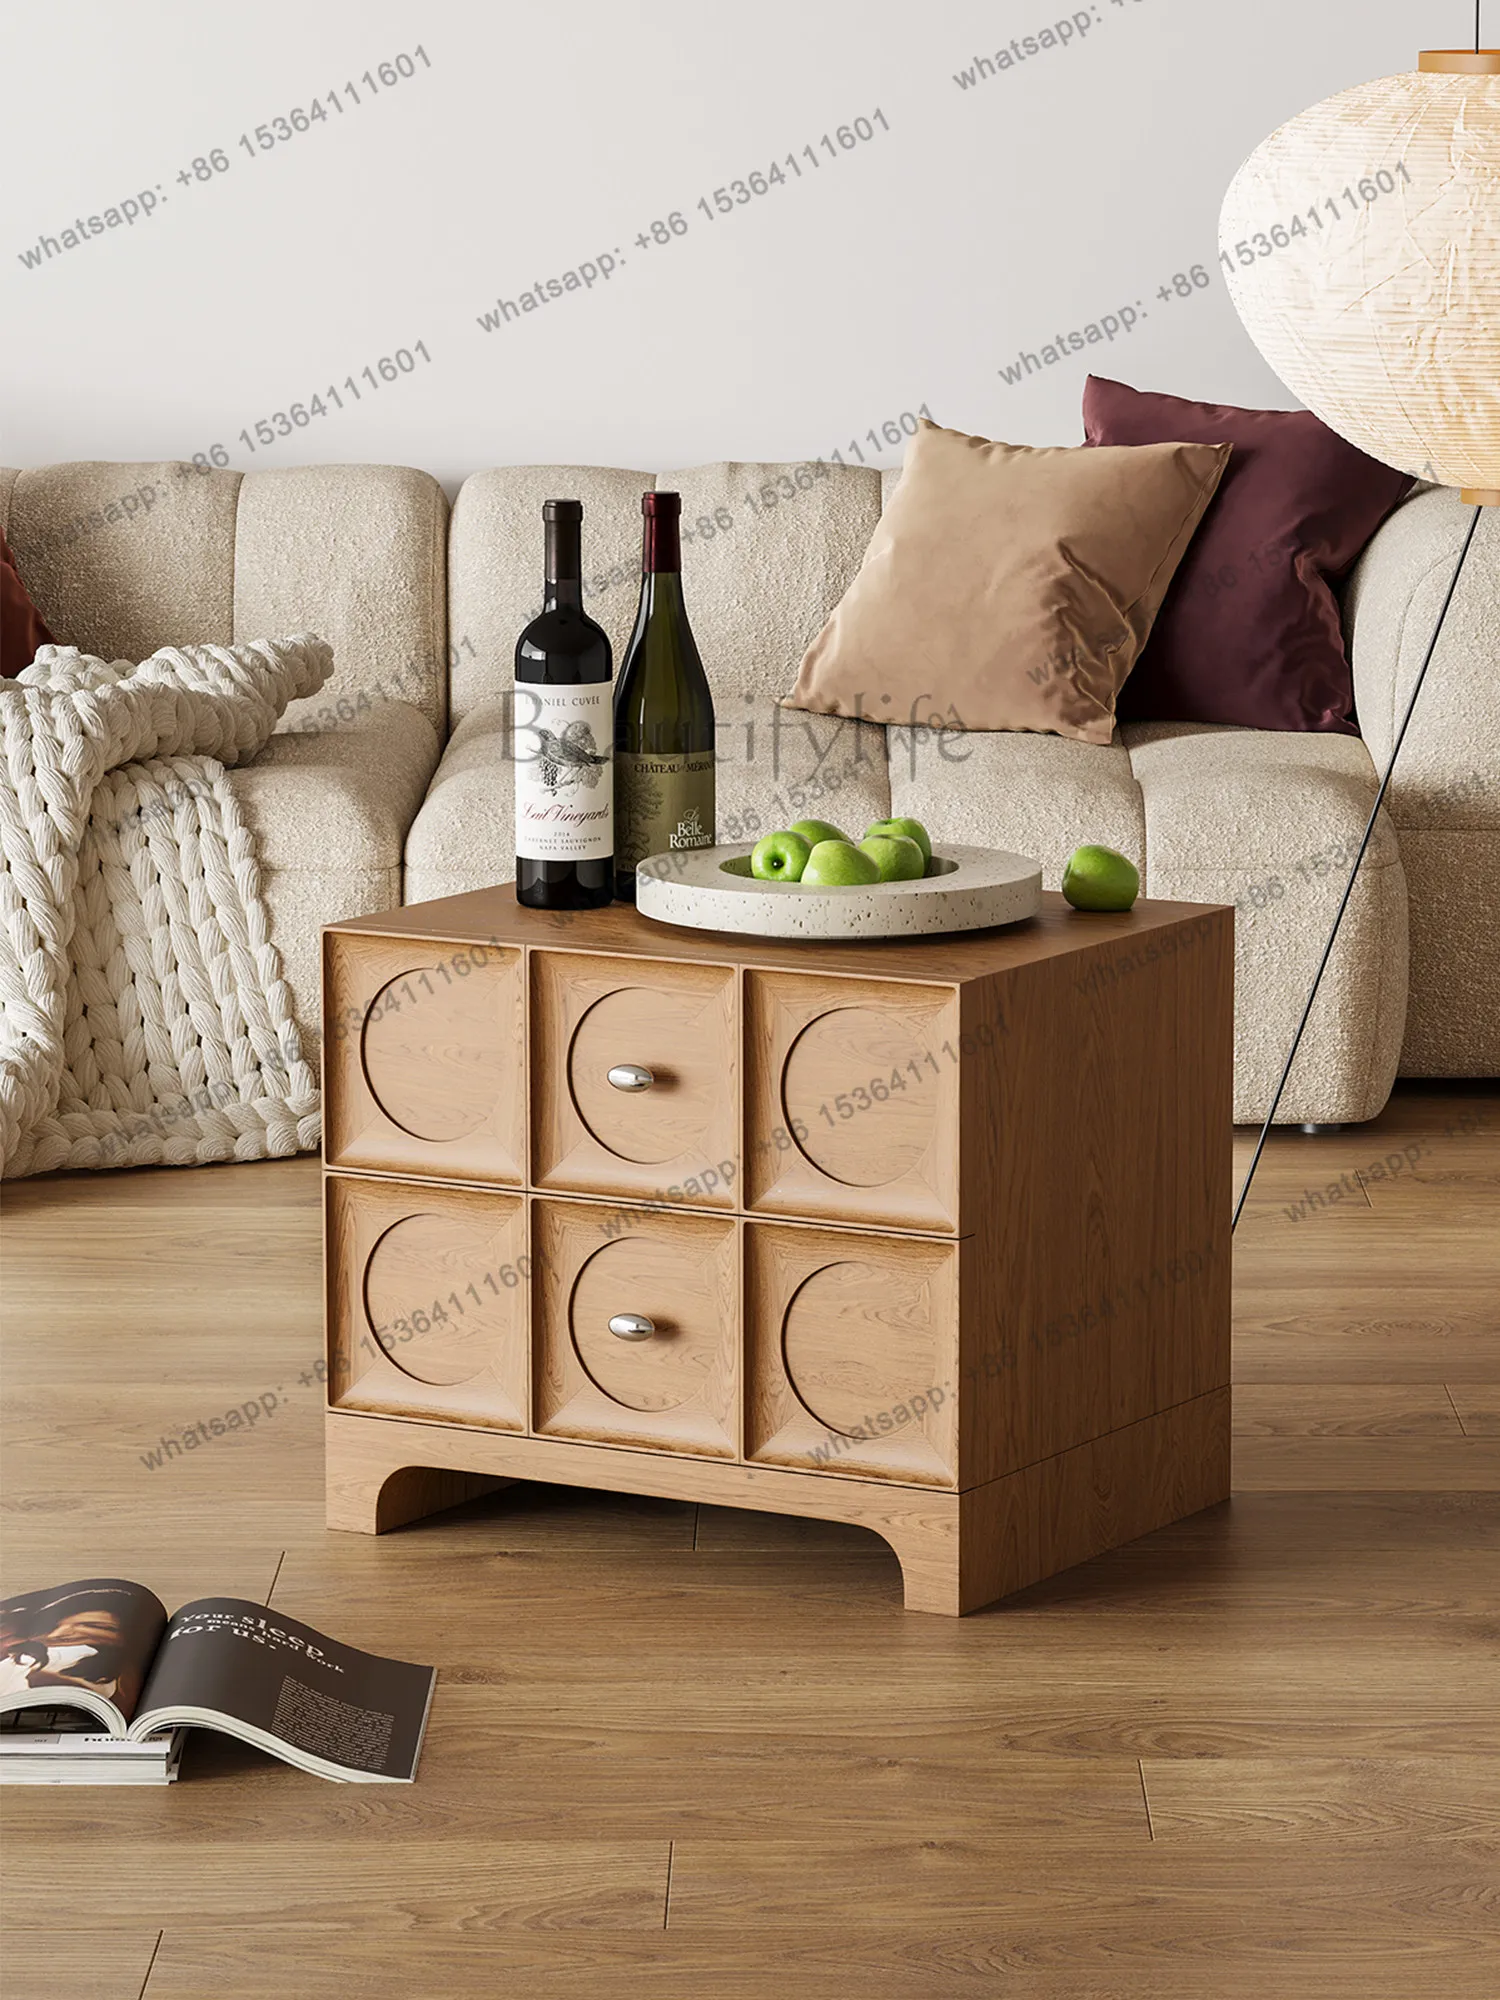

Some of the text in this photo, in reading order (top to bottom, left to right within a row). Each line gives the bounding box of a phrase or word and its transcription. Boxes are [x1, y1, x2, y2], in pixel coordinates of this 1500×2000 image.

[634, 761, 680, 773] CHÂTEAU
[551, 802, 609, 828] Vineyards
[677, 821, 703, 837] Belle
[668, 833, 712, 849] Romaine
[169, 1625, 221, 1641] for
[181, 1613, 324, 1658] your sleep
[207, 1618, 345, 1673] means hard work
